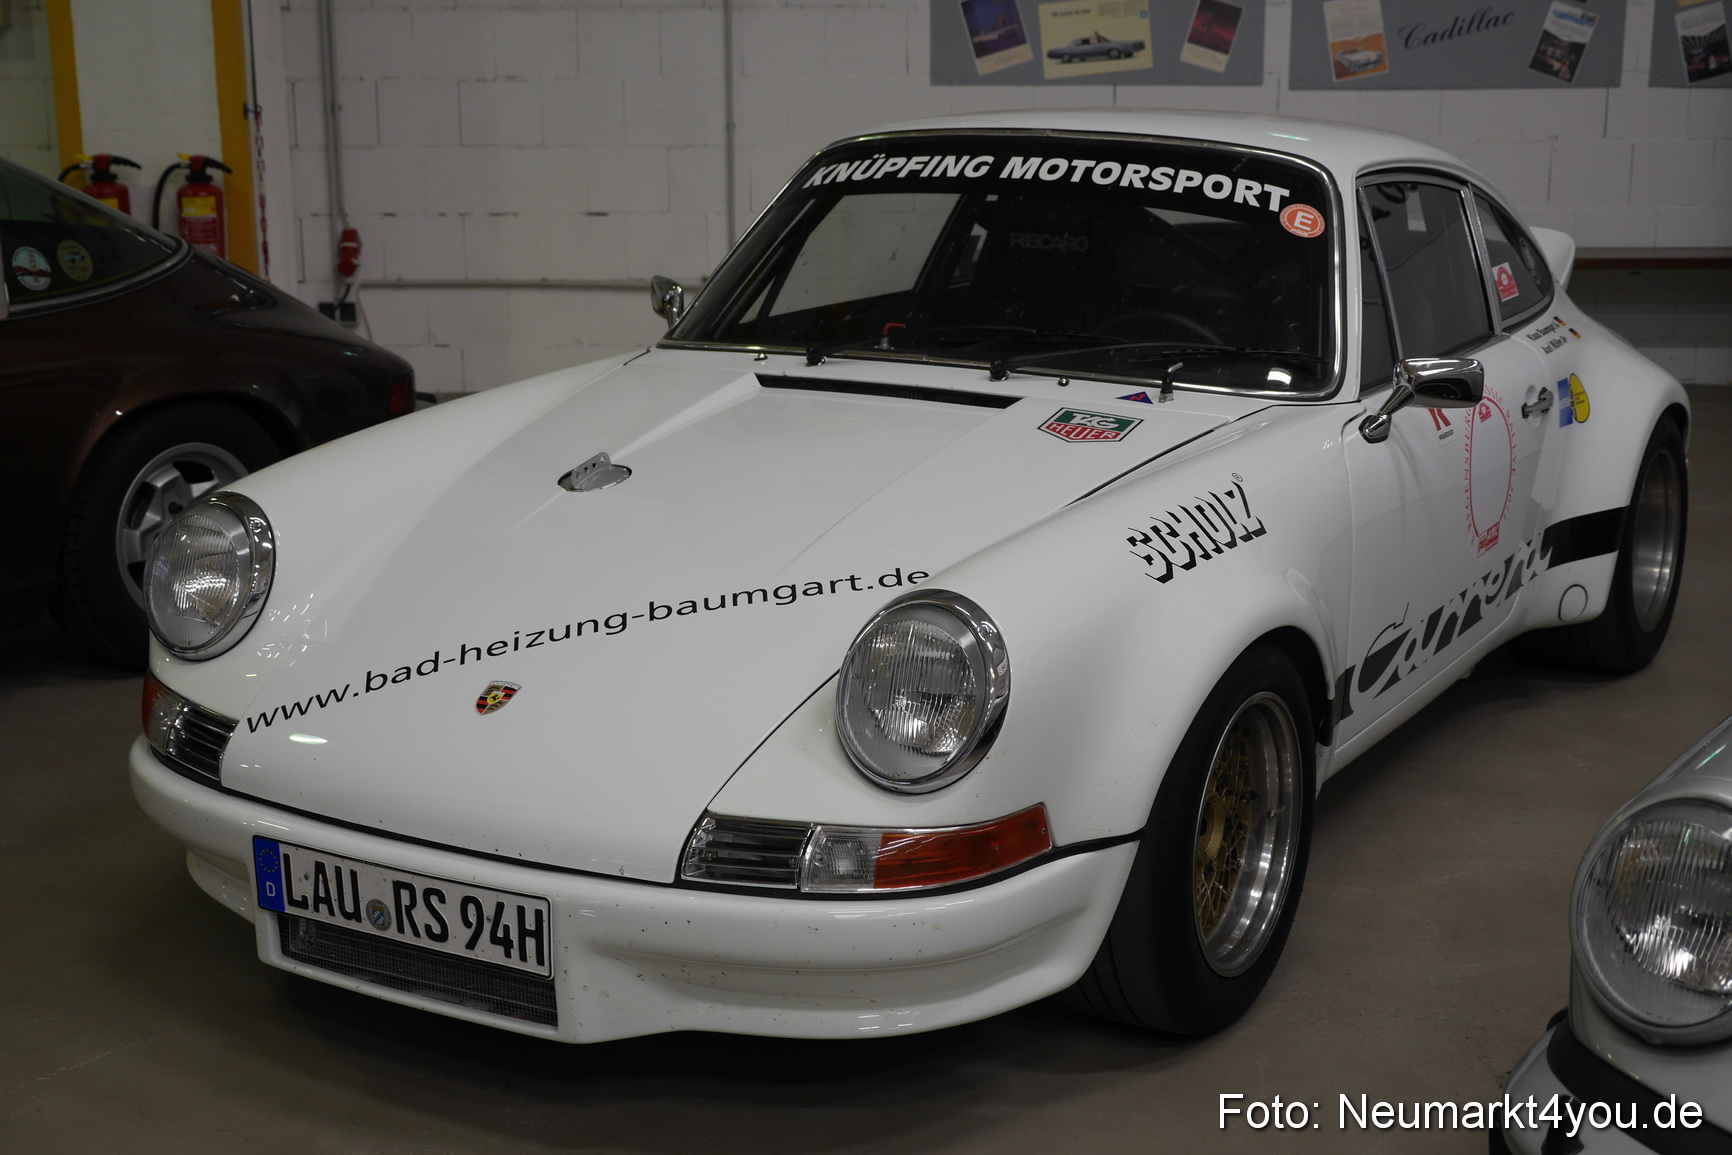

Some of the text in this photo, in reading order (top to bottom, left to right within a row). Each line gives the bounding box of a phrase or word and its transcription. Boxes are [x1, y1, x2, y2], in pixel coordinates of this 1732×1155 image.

[1397, 10, 1516, 51] Cadillac
[803, 152, 1291, 213] KNÜPFING MOTORSPORT
[1293, 211, 1315, 232] E
[1009, 232, 1089, 253] RECARO
[1049, 423, 1117, 440] HEUER
[1067, 412, 1120, 429] TAG
[1126, 481, 1268, 584] SCHOLZ
[1349, 532, 1554, 700] Carrera
[246, 566, 930, 734] www.bad-heizung-baumgart.de
[266, 881, 276, 897] D
[283, 852, 362, 924] LAU
[391, 879, 450, 943] RS
[459, 894, 546, 967] 94H
